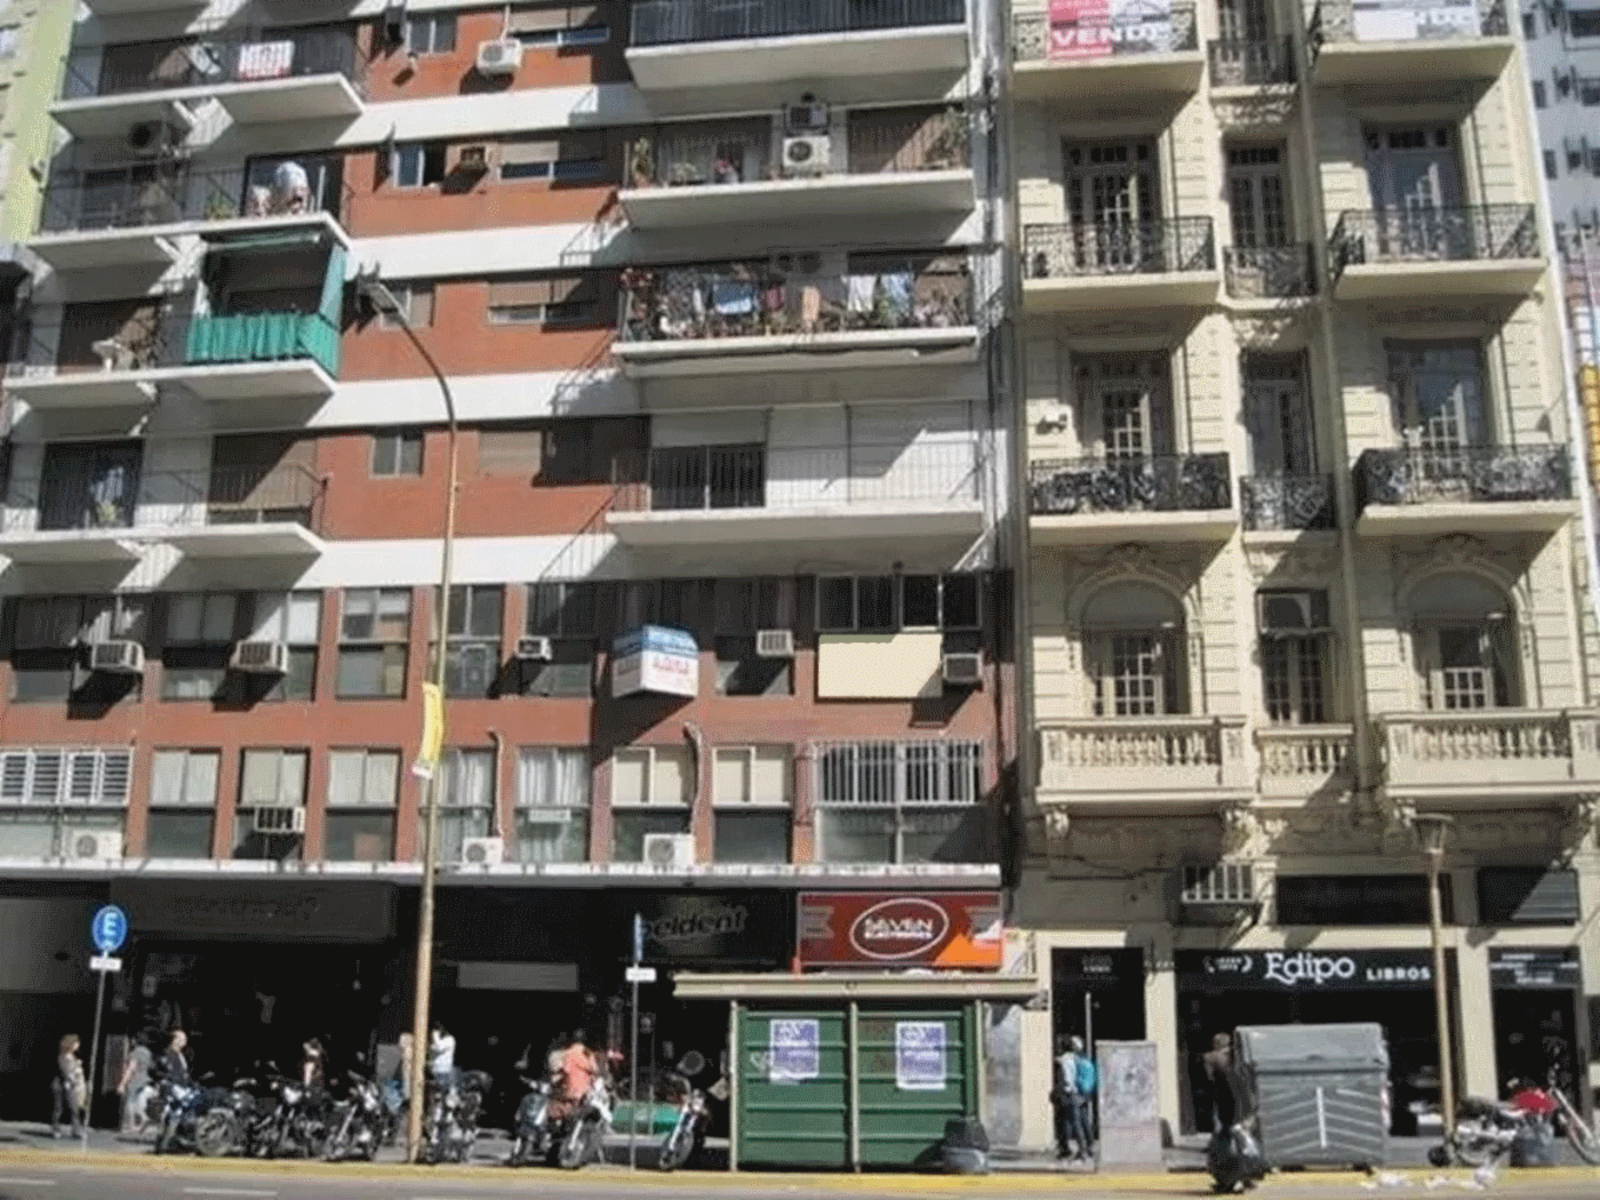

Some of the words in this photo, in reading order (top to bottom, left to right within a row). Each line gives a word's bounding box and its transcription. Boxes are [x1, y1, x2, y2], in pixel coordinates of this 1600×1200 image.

[103, 912, 118, 936] E
[1264, 952, 1356, 985] Edipo
[1366, 966, 1431, 982] LIBROS
